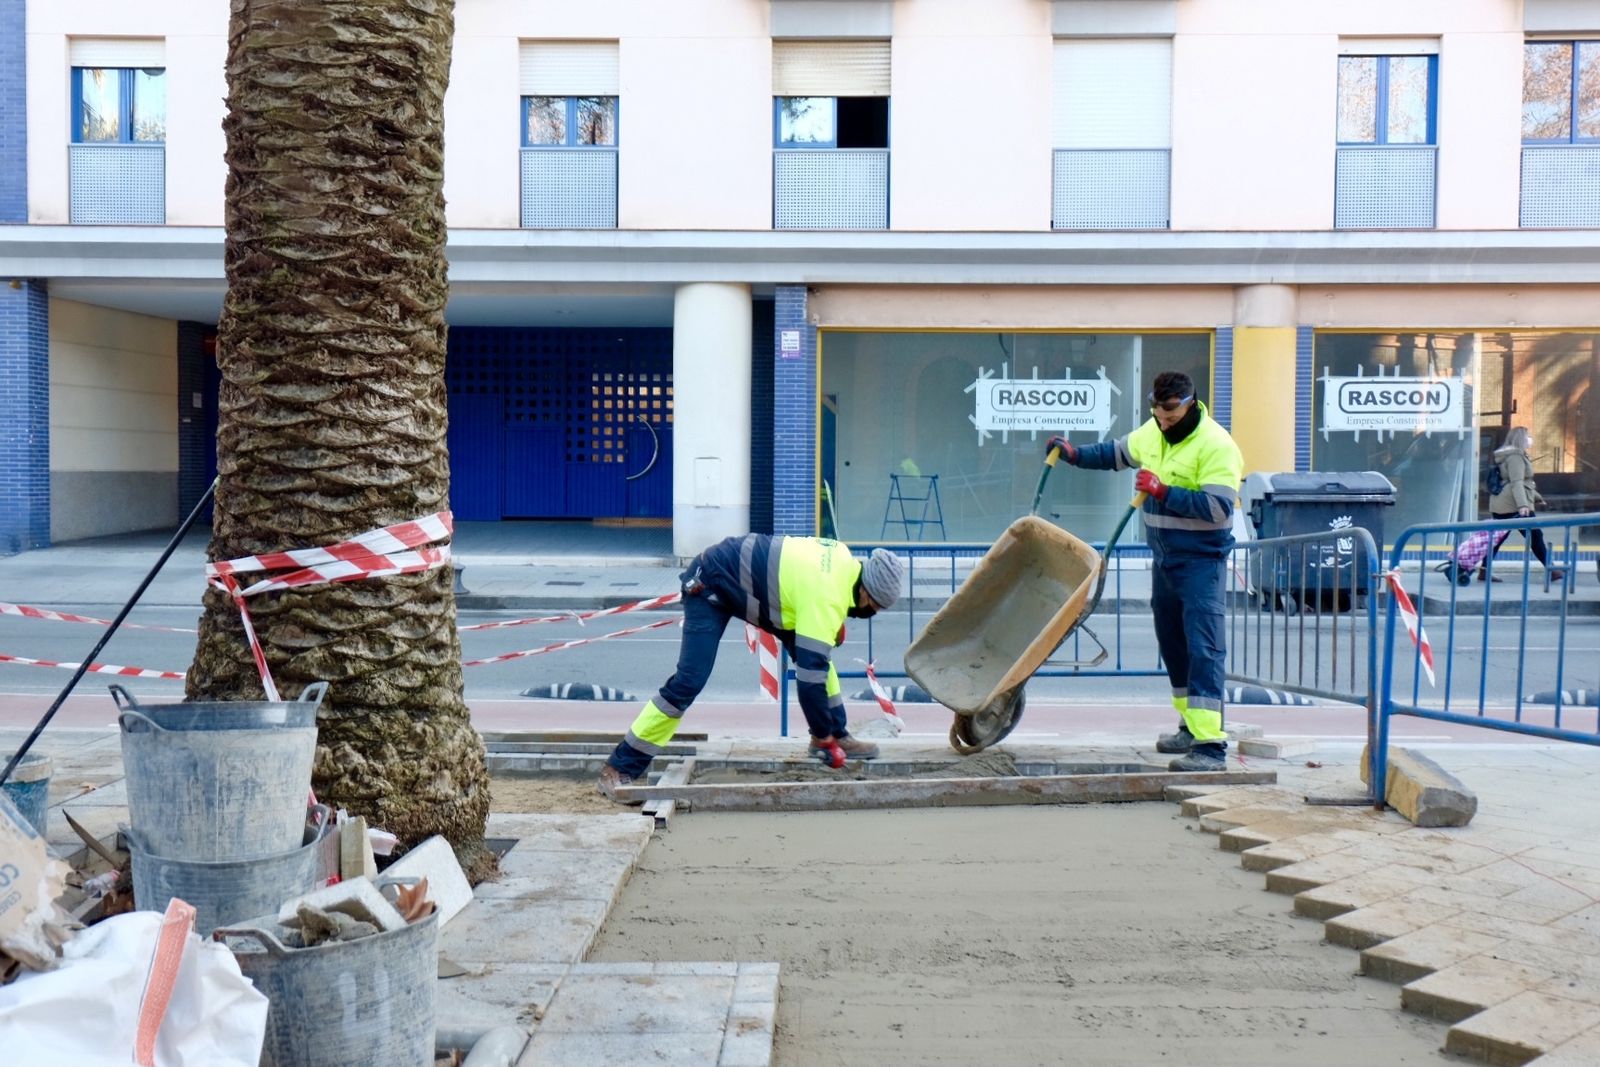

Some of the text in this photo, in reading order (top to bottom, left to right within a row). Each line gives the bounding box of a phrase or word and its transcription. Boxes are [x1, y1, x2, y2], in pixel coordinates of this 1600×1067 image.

[999, 390, 1088, 406] RASCON
[1348, 390, 1441, 406] RASCON
[992, 415, 1095, 425] Empresa Constructora
[1346, 416, 1385, 426] Empresa
